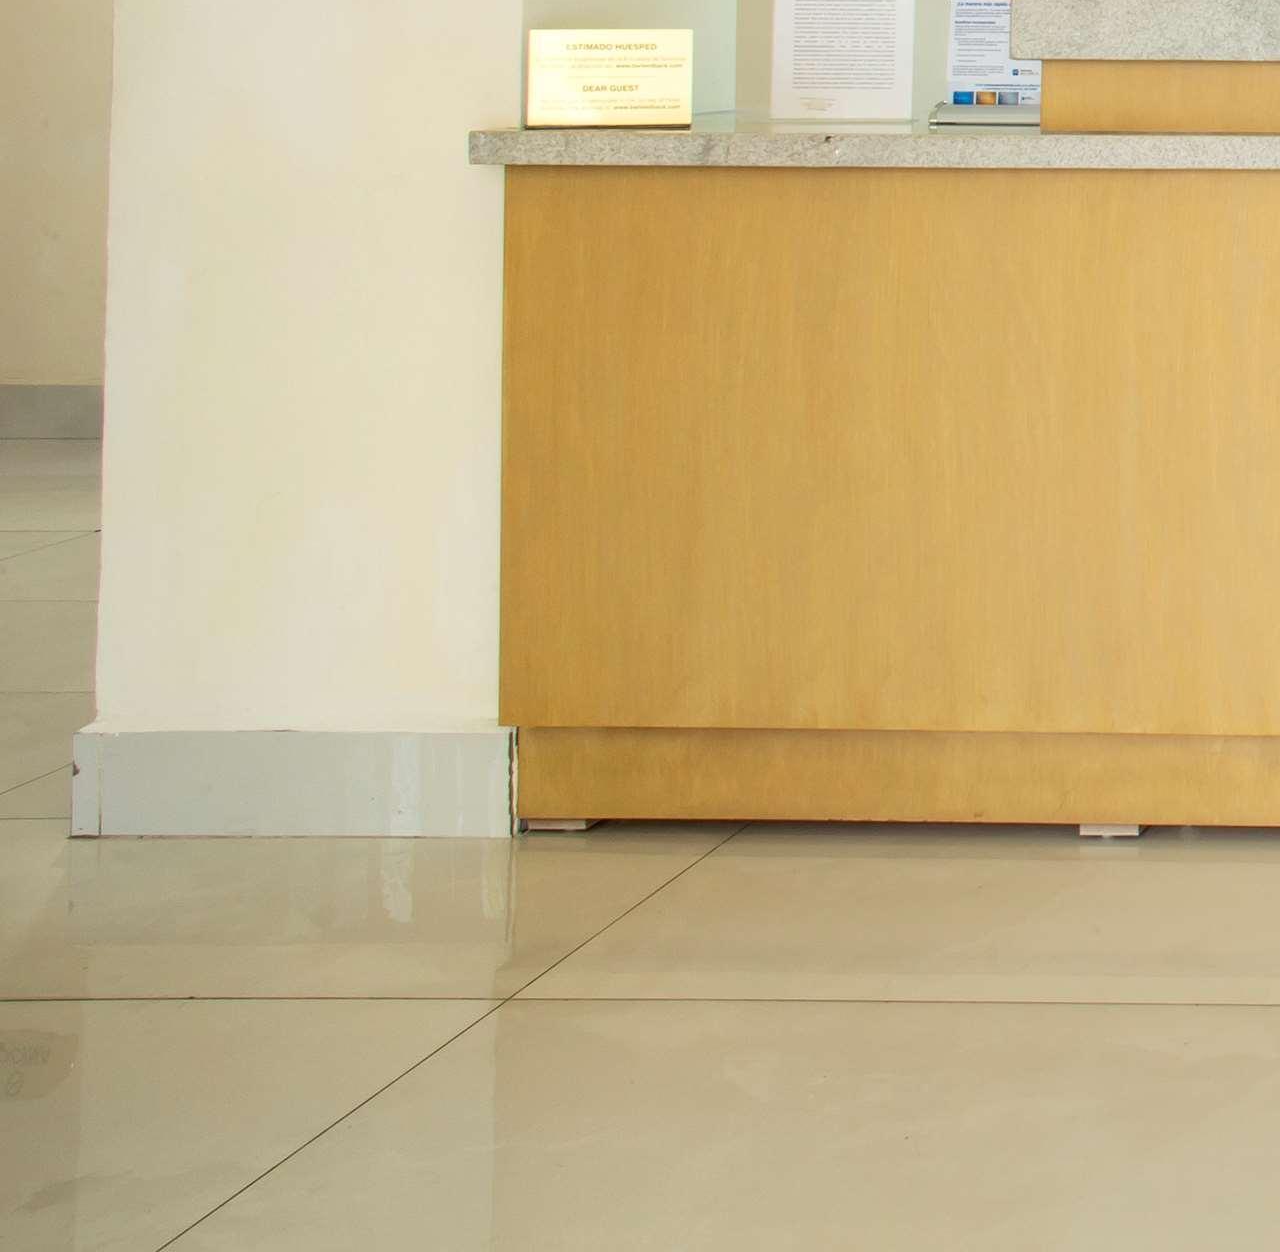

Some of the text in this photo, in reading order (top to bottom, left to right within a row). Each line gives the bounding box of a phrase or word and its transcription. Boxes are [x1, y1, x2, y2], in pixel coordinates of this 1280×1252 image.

[566, 43, 613, 51] ESTIMADO
[582, 84, 639, 92] DEAR GUEST
